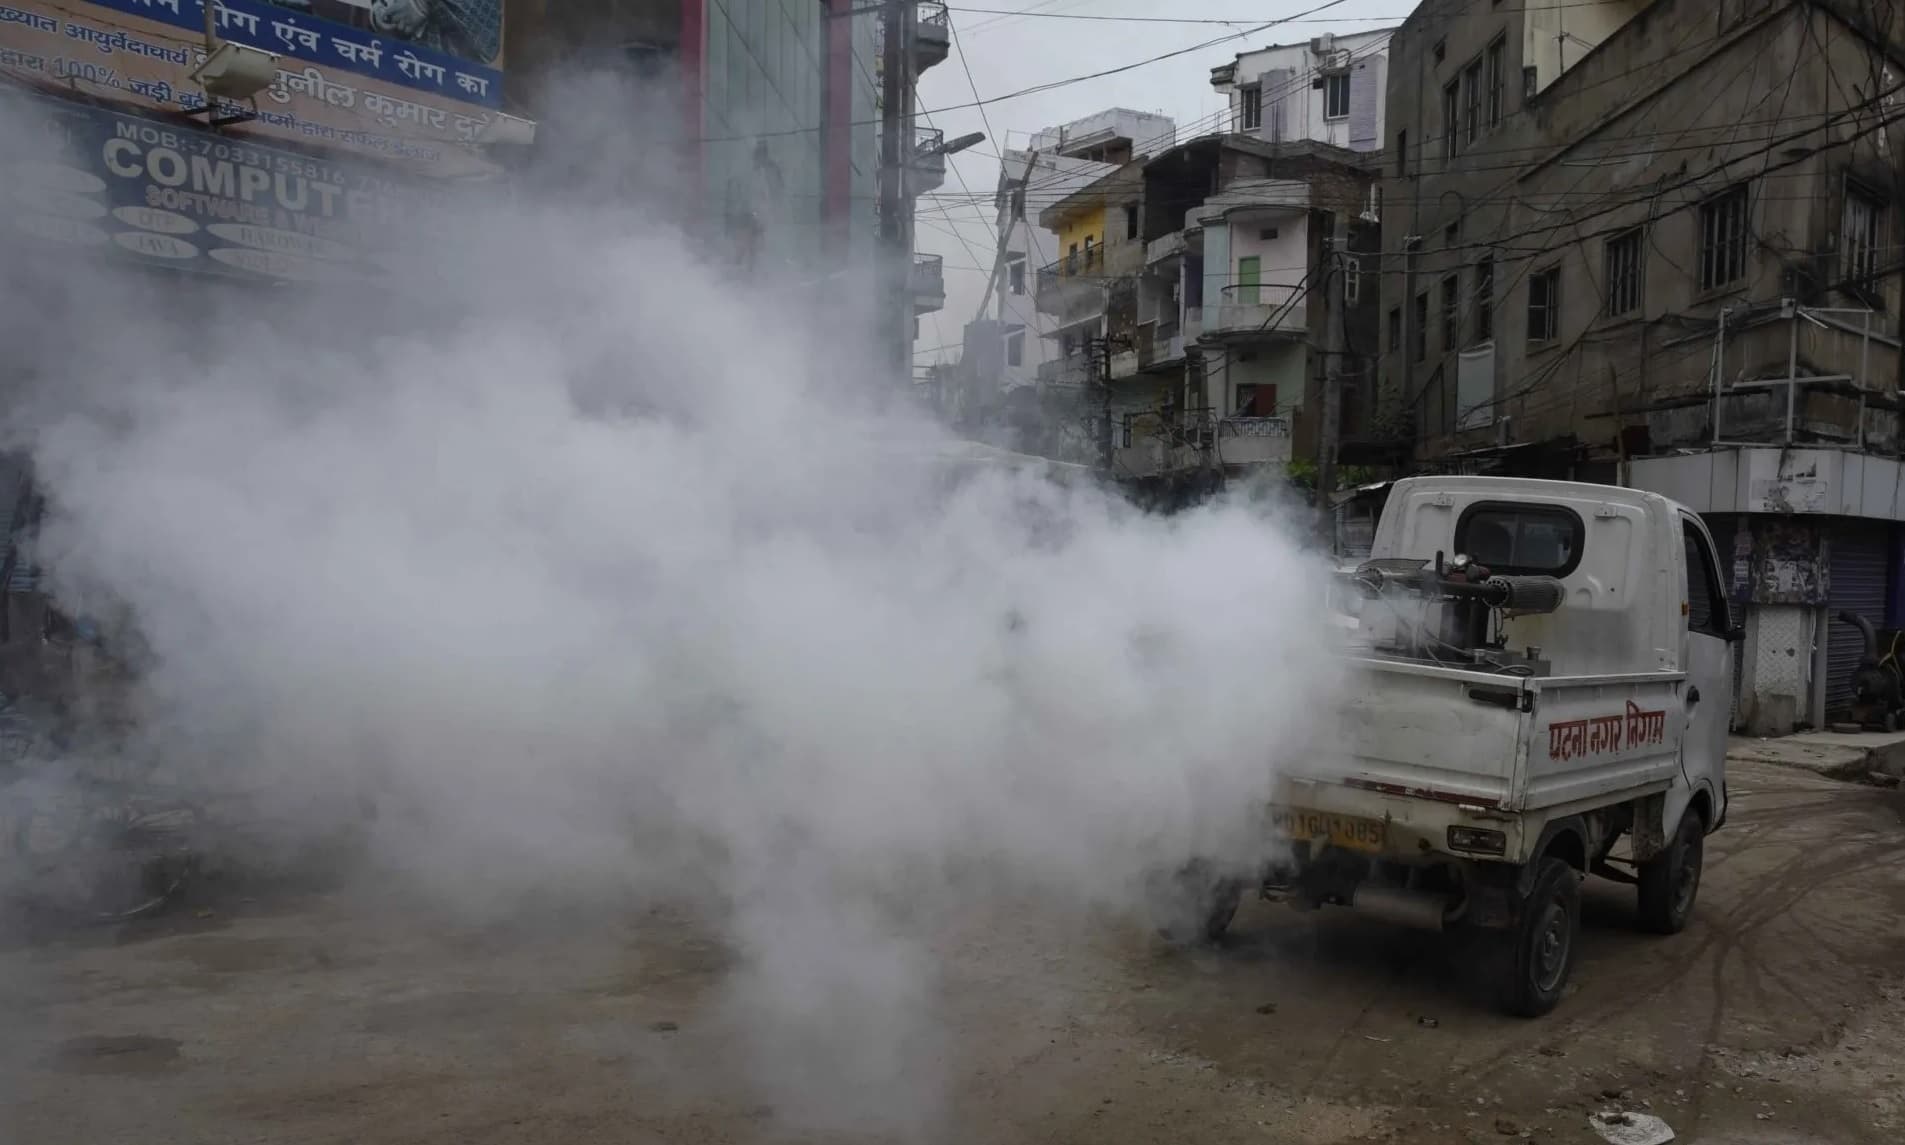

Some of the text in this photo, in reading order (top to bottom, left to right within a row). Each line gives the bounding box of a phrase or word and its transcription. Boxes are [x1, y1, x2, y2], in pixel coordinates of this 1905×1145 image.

[54, 57, 121, 88] 100%
[197, 0, 261, 37] ोग
[272, 17, 321, 52] एंव
[331, 38, 383, 70] चर्म
[393, 51, 446, 88] रोग
[455, 70, 489, 98] का
[1549, 700, 1666, 761] पटना नगर निगम
